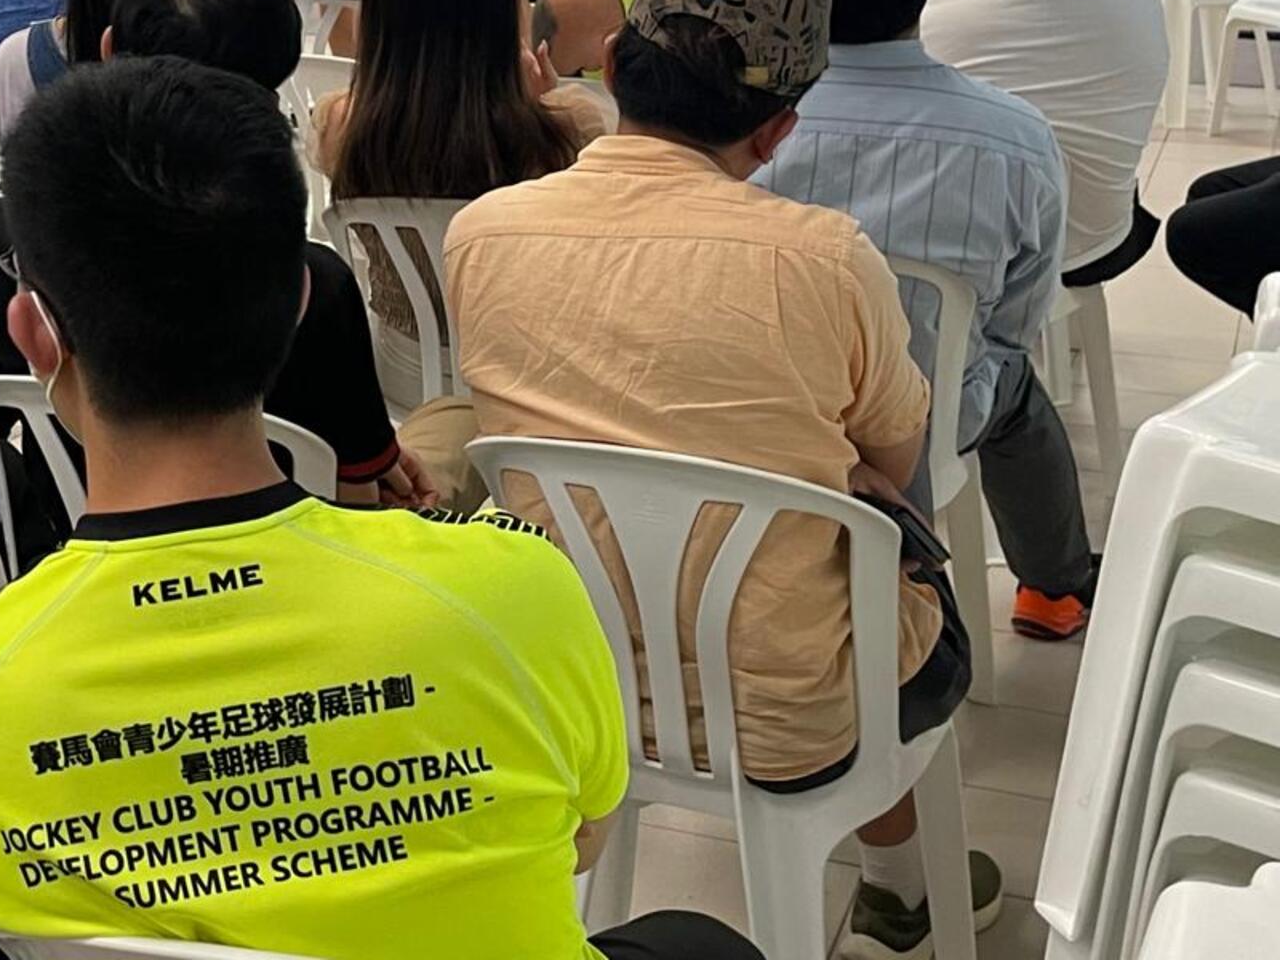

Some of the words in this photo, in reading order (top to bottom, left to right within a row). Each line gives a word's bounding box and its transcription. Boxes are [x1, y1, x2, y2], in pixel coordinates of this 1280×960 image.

[132, 563, 264, 607] KELME
[29, 674, 415, 775] 賽馬會青少年足球發展計劃
[180, 735, 310, 784] 暑期推廣
[0, 811, 101, 854] JOCKEY
[112, 794, 197, 833] CLUB
[202, 773, 321, 815] YOUTH
[330, 747, 493, 796] FOOTBALL
[19, 824, 240, 888] DEVELOPMENT
[251, 787, 473, 847] PROGRAMME
[114, 862, 264, 908] SUMMER
[271, 835, 408, 882] SCHEME
